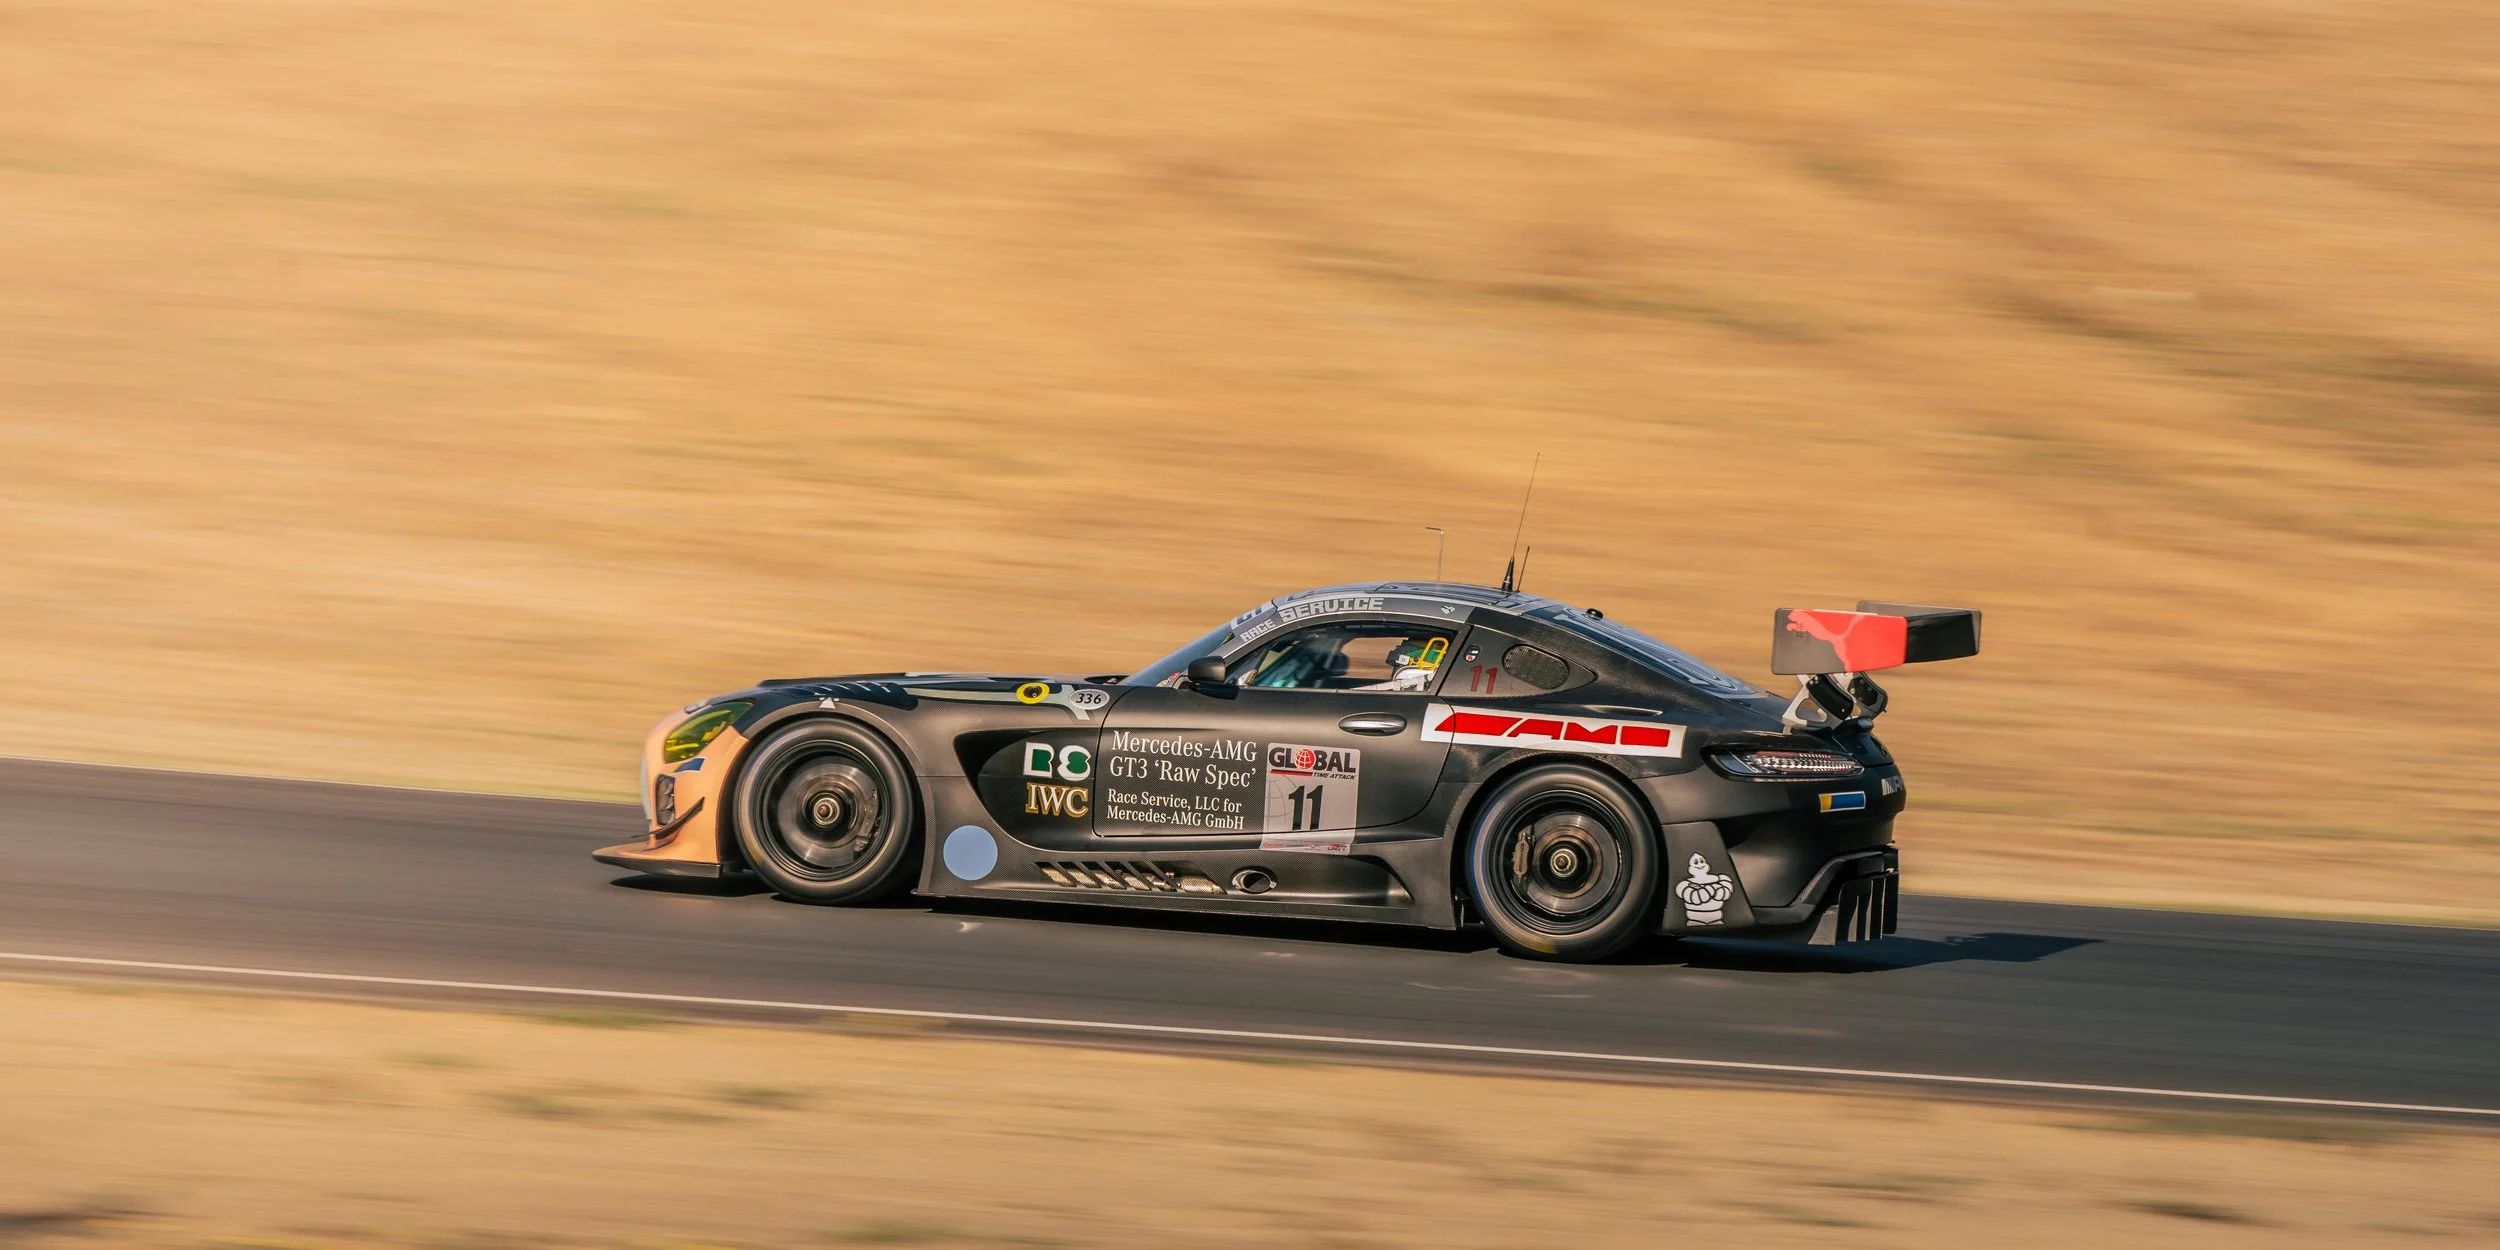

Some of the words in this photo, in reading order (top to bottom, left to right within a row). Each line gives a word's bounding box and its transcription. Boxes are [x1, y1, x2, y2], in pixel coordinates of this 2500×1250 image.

[1240, 618, 1276, 643] RACE
[1278, 597, 1385, 623] SERVICE
[1470, 665, 1498, 695] 11
[1075, 692, 1102, 705] 336
[1111, 730, 1257, 762] Mercedes-AMG
[1268, 747, 1356, 773] GLOBAL
[1110, 755, 1148, 778] GT3
[1025, 782, 1089, 818] IWC
[1108, 788, 1138, 804] Race
[1141, 791, 1191, 811] Service,
[1194, 796, 1220, 812] LLC
[1222, 799, 1242, 813] for
[1288, 785, 1324, 831] 11
[1107, 805, 1201, 826] Mercedes-AMG
[1205, 815, 1244, 830] GmbH
